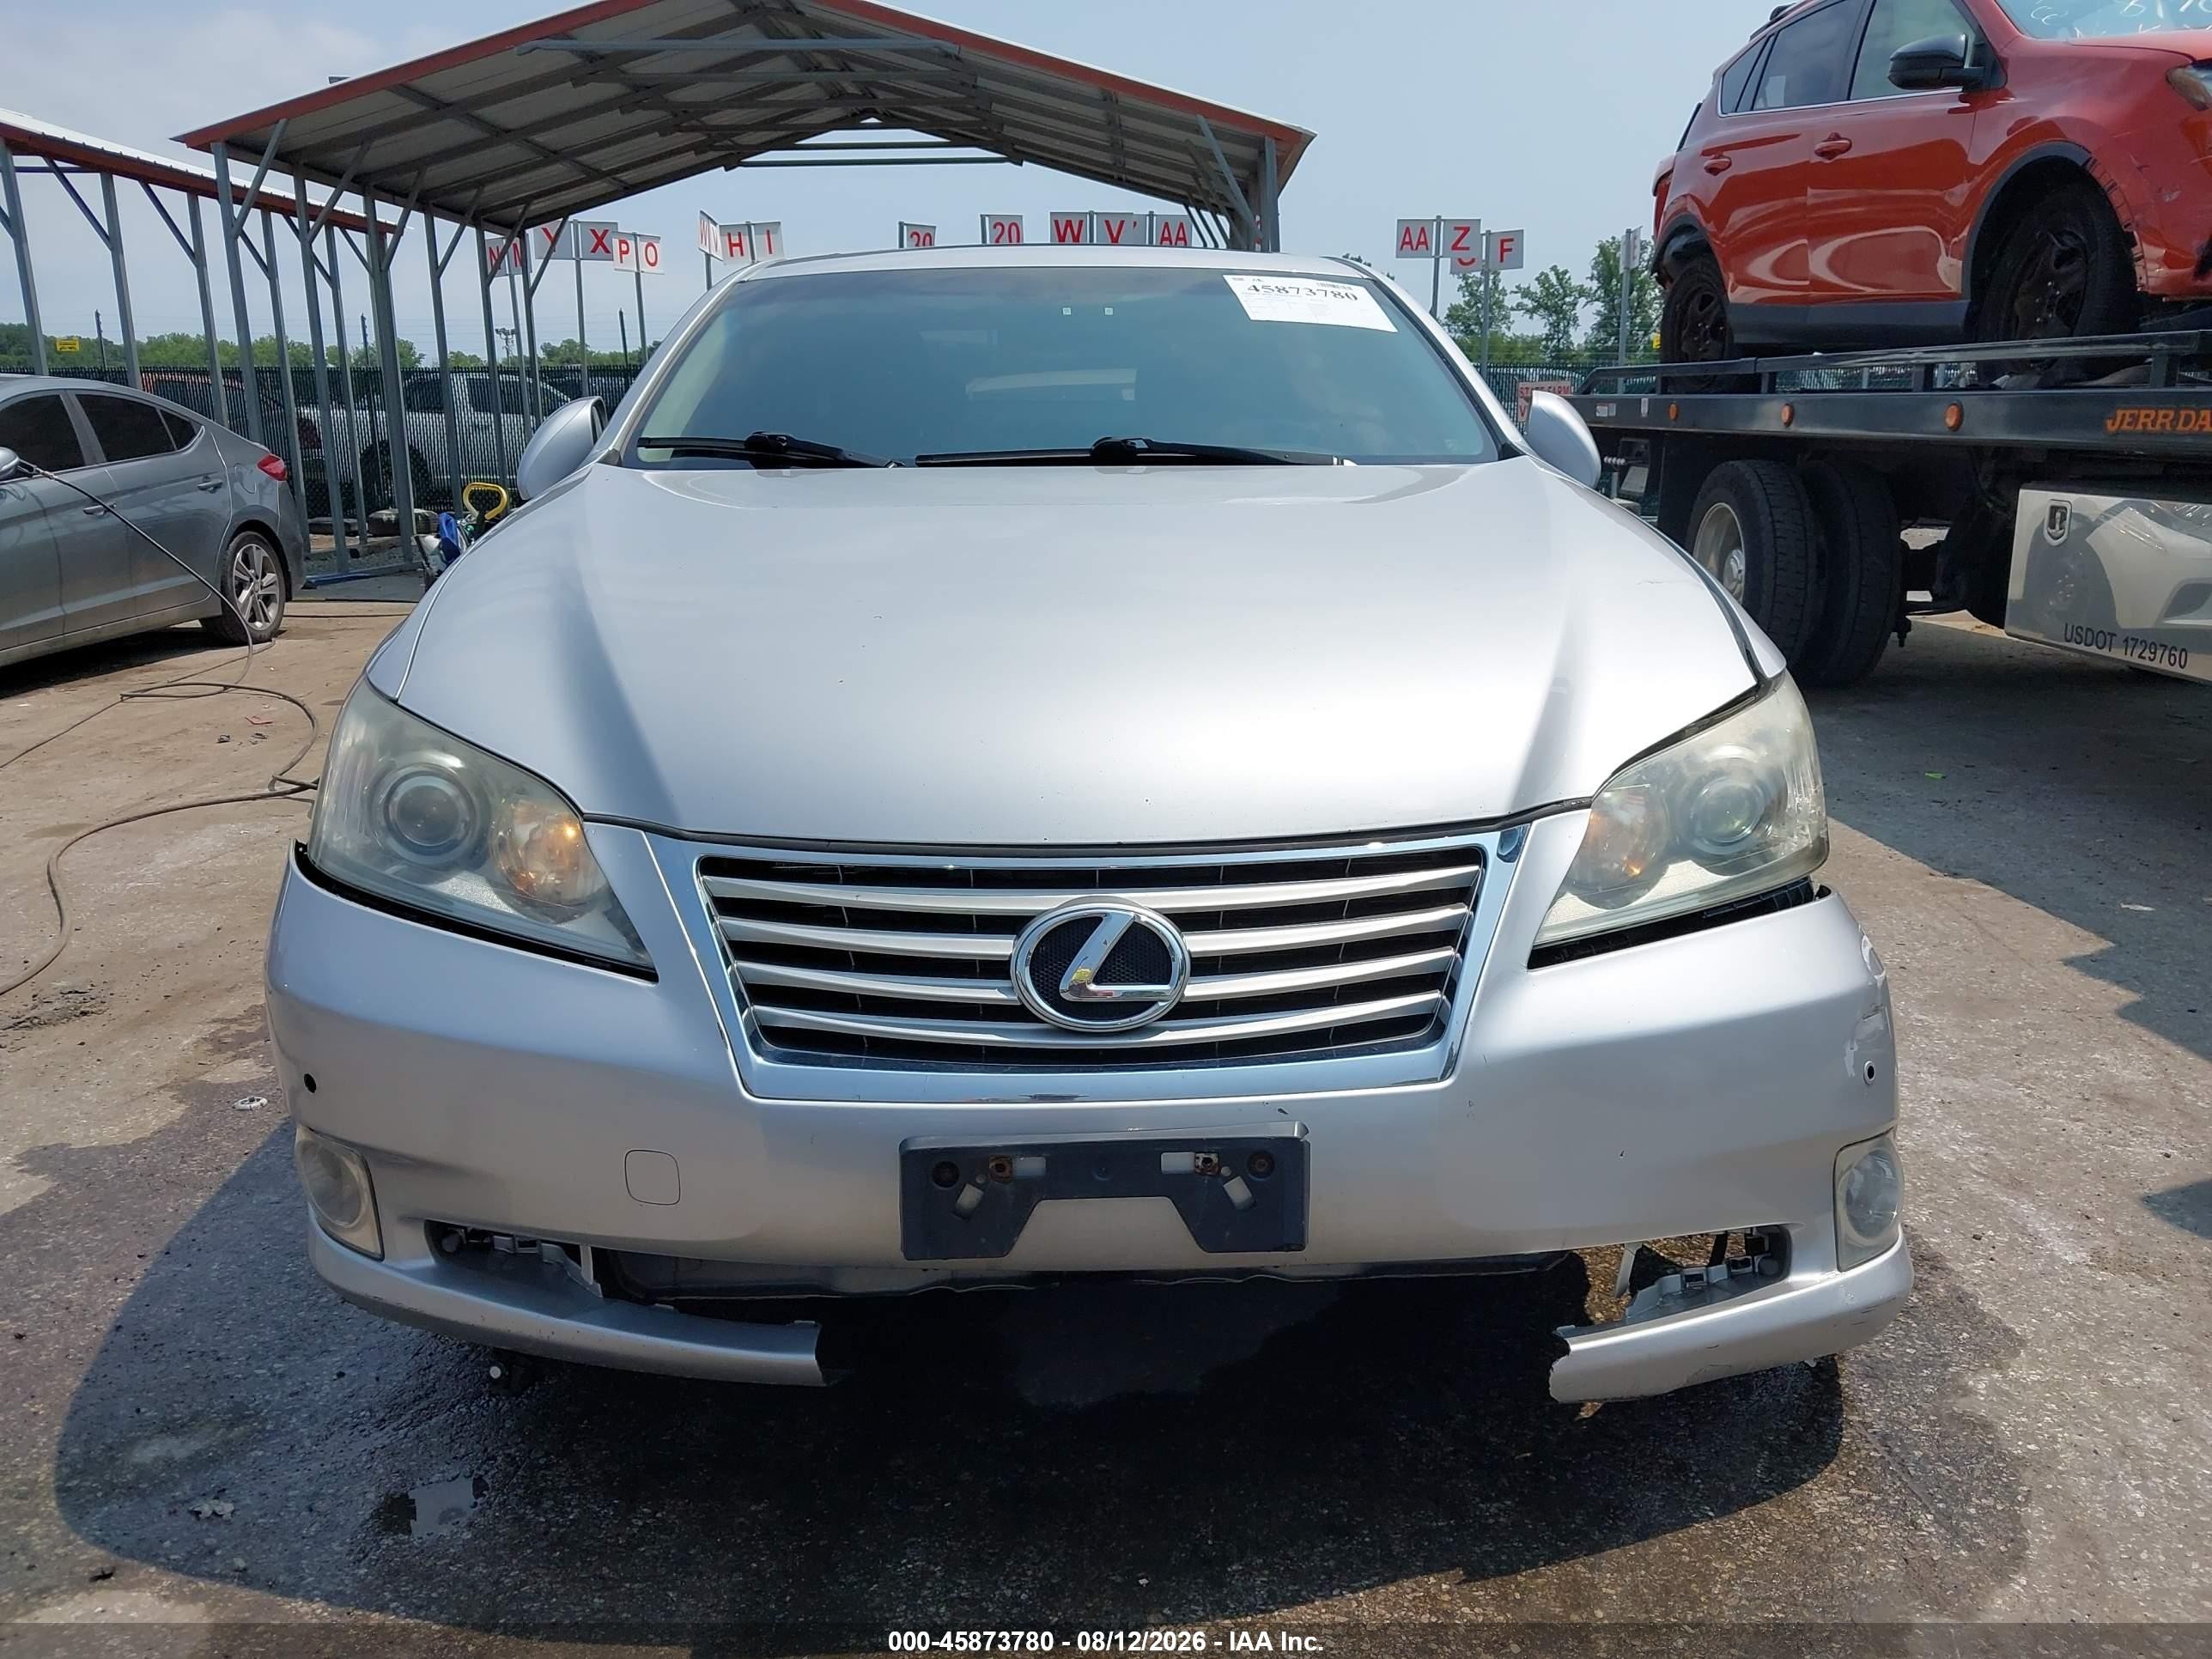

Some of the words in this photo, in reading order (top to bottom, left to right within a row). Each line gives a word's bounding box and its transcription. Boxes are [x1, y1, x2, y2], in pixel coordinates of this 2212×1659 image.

[590, 228, 611, 254] X
[993, 222, 1021, 243] 20
[1054, 219, 1084, 243] W
[1104, 219, 1125, 243] V
[1160, 221, 1188, 246] AA
[1400, 227, 1429, 251] AA
[1451, 226, 1471, 251] Z
[618, 239, 630, 264] P
[727, 231, 744, 258] H
[1499, 238, 1515, 263] F
[1247, 283, 1358, 301] 45873780
[2064, 623, 2117, 653] USDOT
[2123, 635, 2188, 669] 1729760
